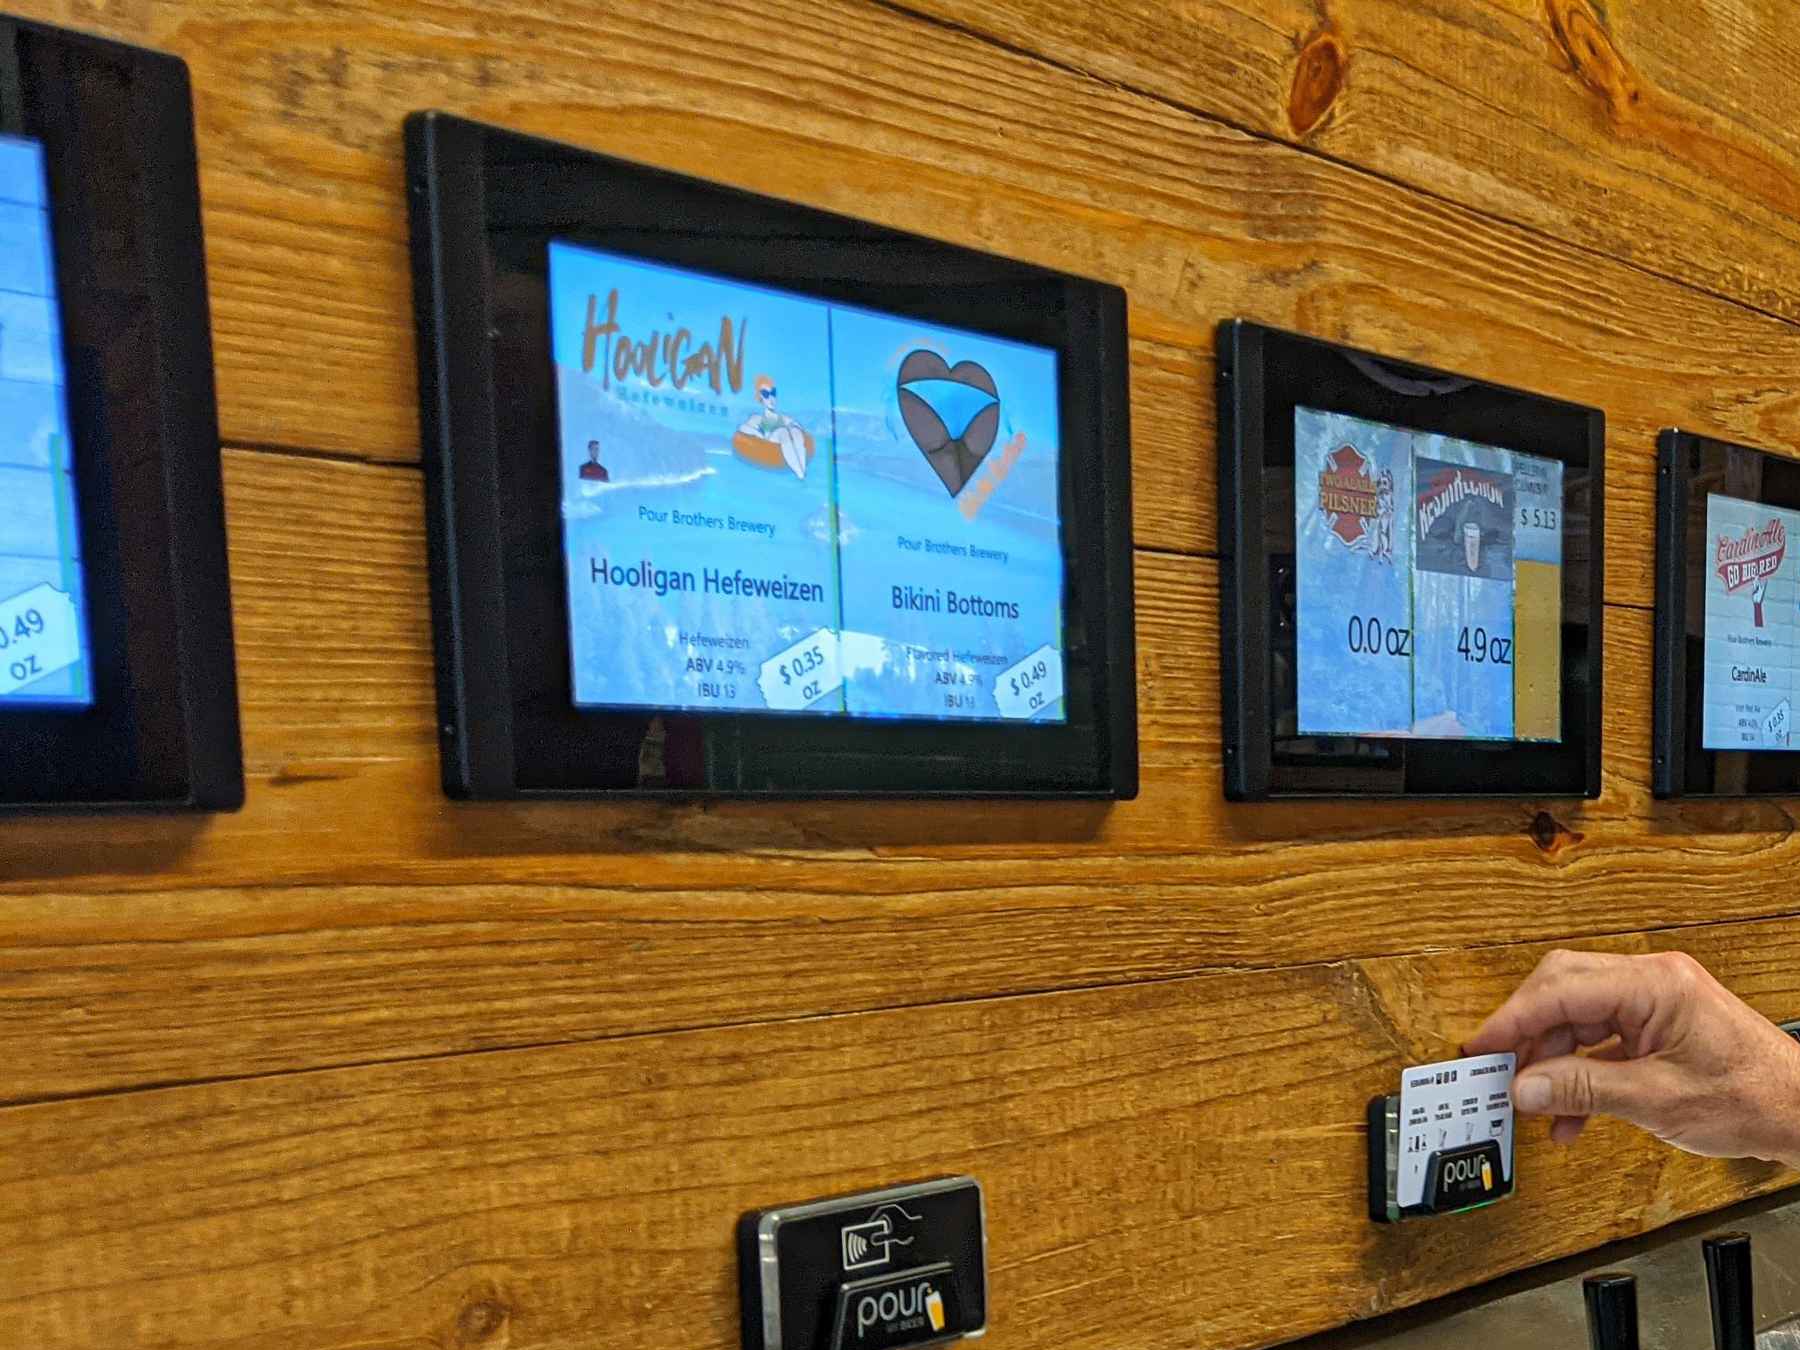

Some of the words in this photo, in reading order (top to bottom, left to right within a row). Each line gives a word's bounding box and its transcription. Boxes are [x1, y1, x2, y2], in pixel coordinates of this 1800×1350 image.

[638, 505, 668, 521] Pour
[673, 509, 724, 529] Brothers
[727, 516, 776, 538] Brewery
[1533, 508, 1556, 529] 5.13
[897, 536, 922, 551] Pour
[925, 539, 966, 557] Brothers
[969, 544, 1008, 564] Brewery
[590, 557, 696, 597] Hooligan
[703, 567, 824, 602] Hefeweizen
[1727, 565, 1739, 588] GO
[1759, 555, 1777, 575] RED
[891, 585, 941, 613] Bikini
[947, 591, 1020, 620] Bottoms
[679, 632, 749, 649] Hefeweizen
[1348, 615, 1382, 654] 0.0
[1457, 626, 1487, 662] 4.9
[686, 657, 713, 672] ABV
[778, 664, 791, 685] $
[792, 645, 824, 677] 0.35
[935, 671, 957, 685] ABV
[1021, 660, 1047, 689] 0.49
[1731, 665, 1767, 683] CardinAle
[698, 683, 720, 698] IBU
[1444, 1154, 1487, 1193] pour
[857, 1282, 931, 1339] pour
